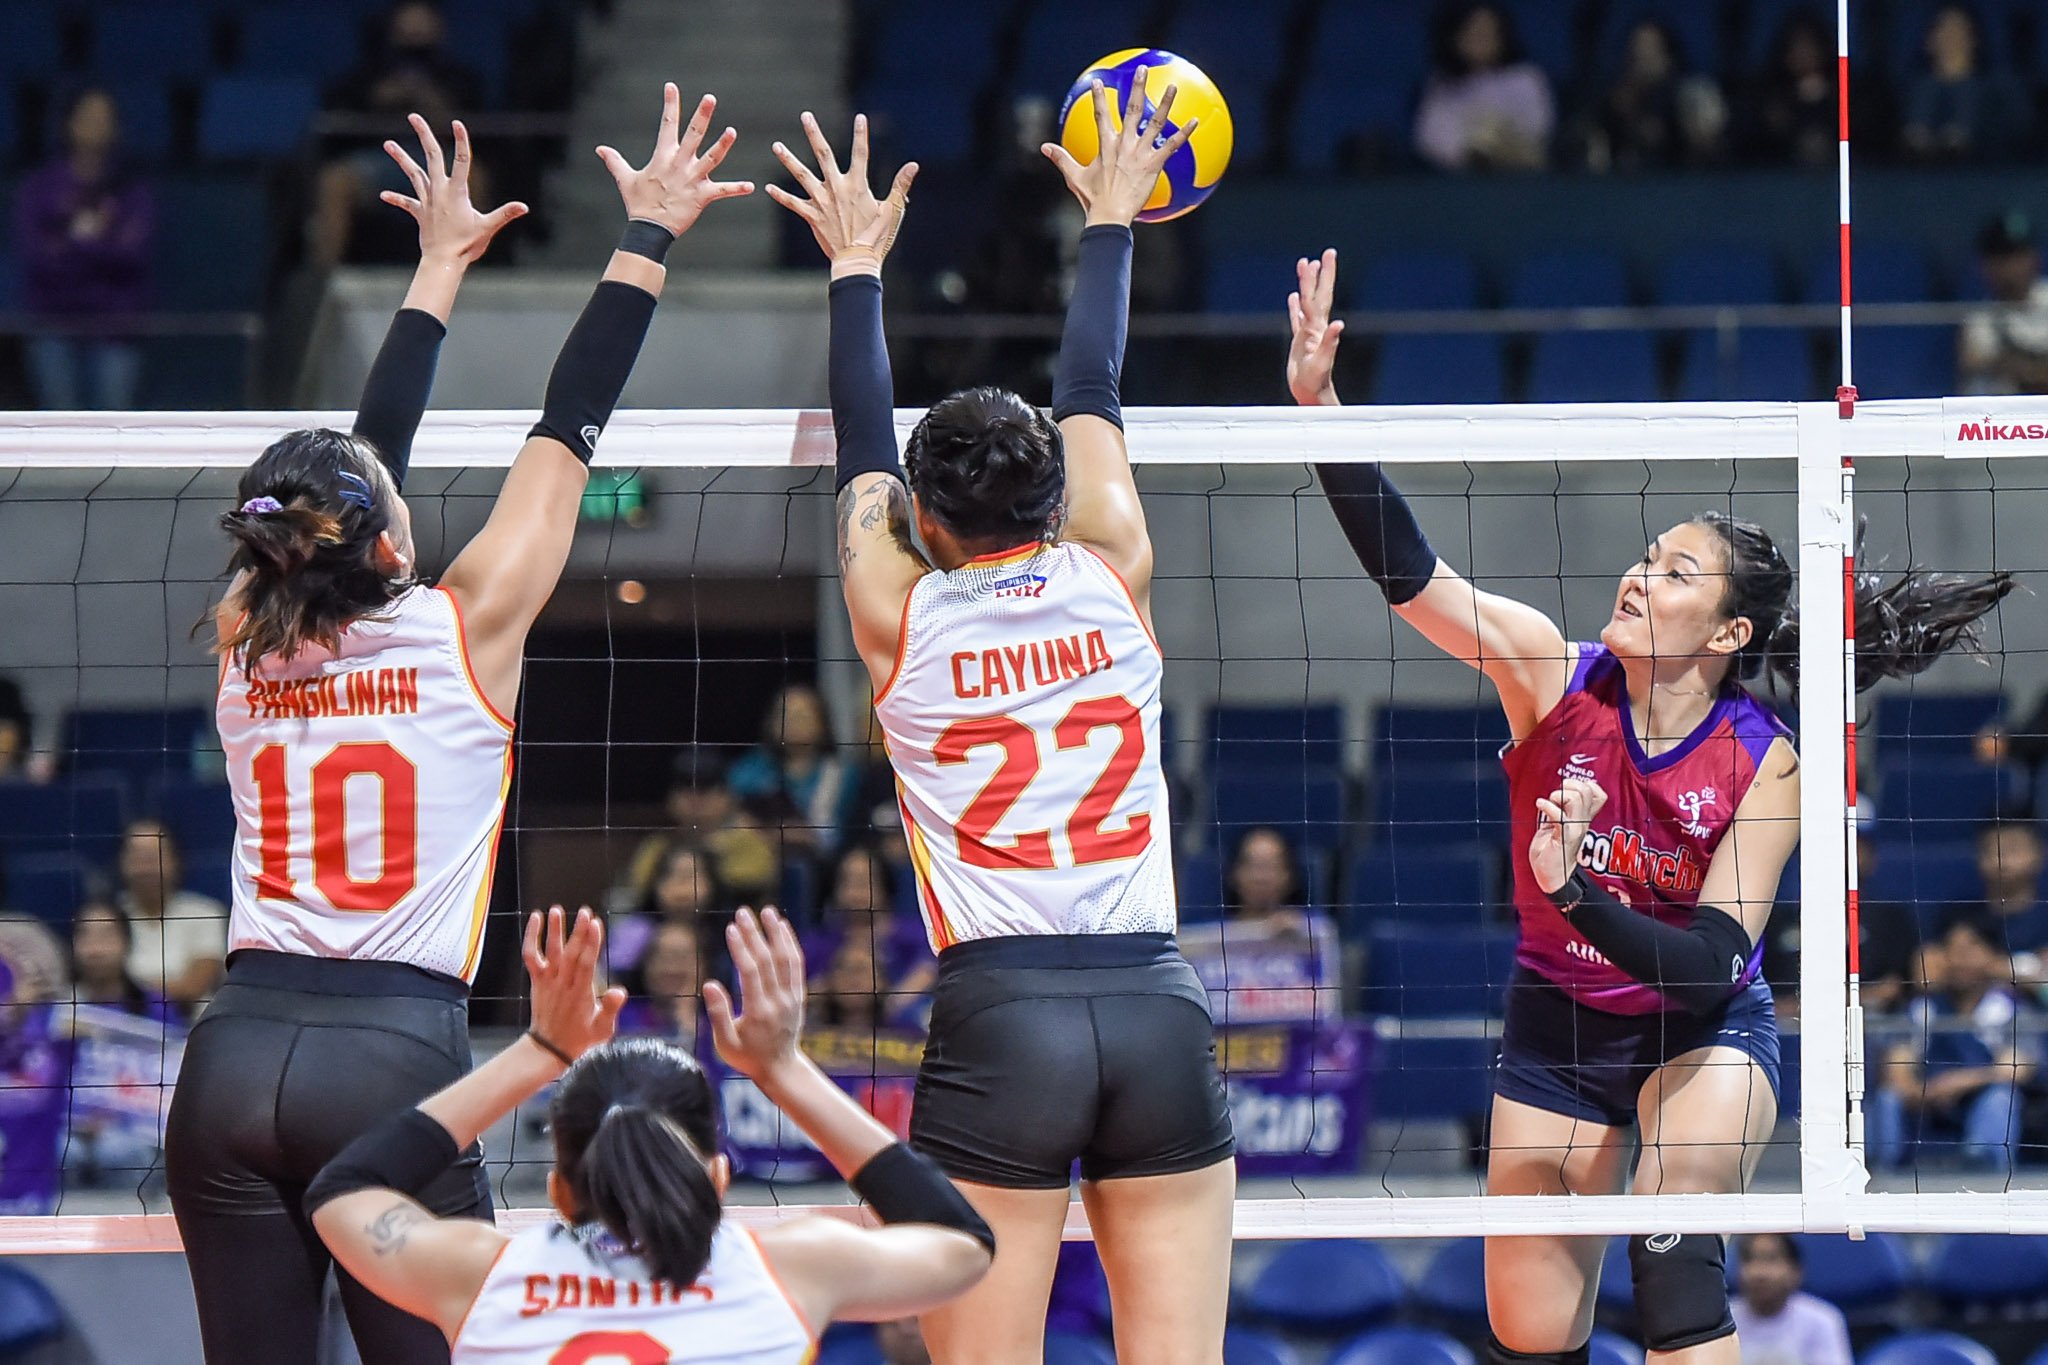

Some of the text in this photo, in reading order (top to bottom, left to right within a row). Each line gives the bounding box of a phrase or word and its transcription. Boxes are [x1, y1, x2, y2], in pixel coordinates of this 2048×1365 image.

[1958, 416, 2048, 441] MIKAS
[996, 585, 1032, 598] LIVE
[246, 667, 418, 719] PANGILINAN
[951, 628, 1113, 699] CAYUNA
[931, 692, 1152, 871] 22
[251, 740, 418, 913] 10
[1576, 828, 1703, 891] coMuch
